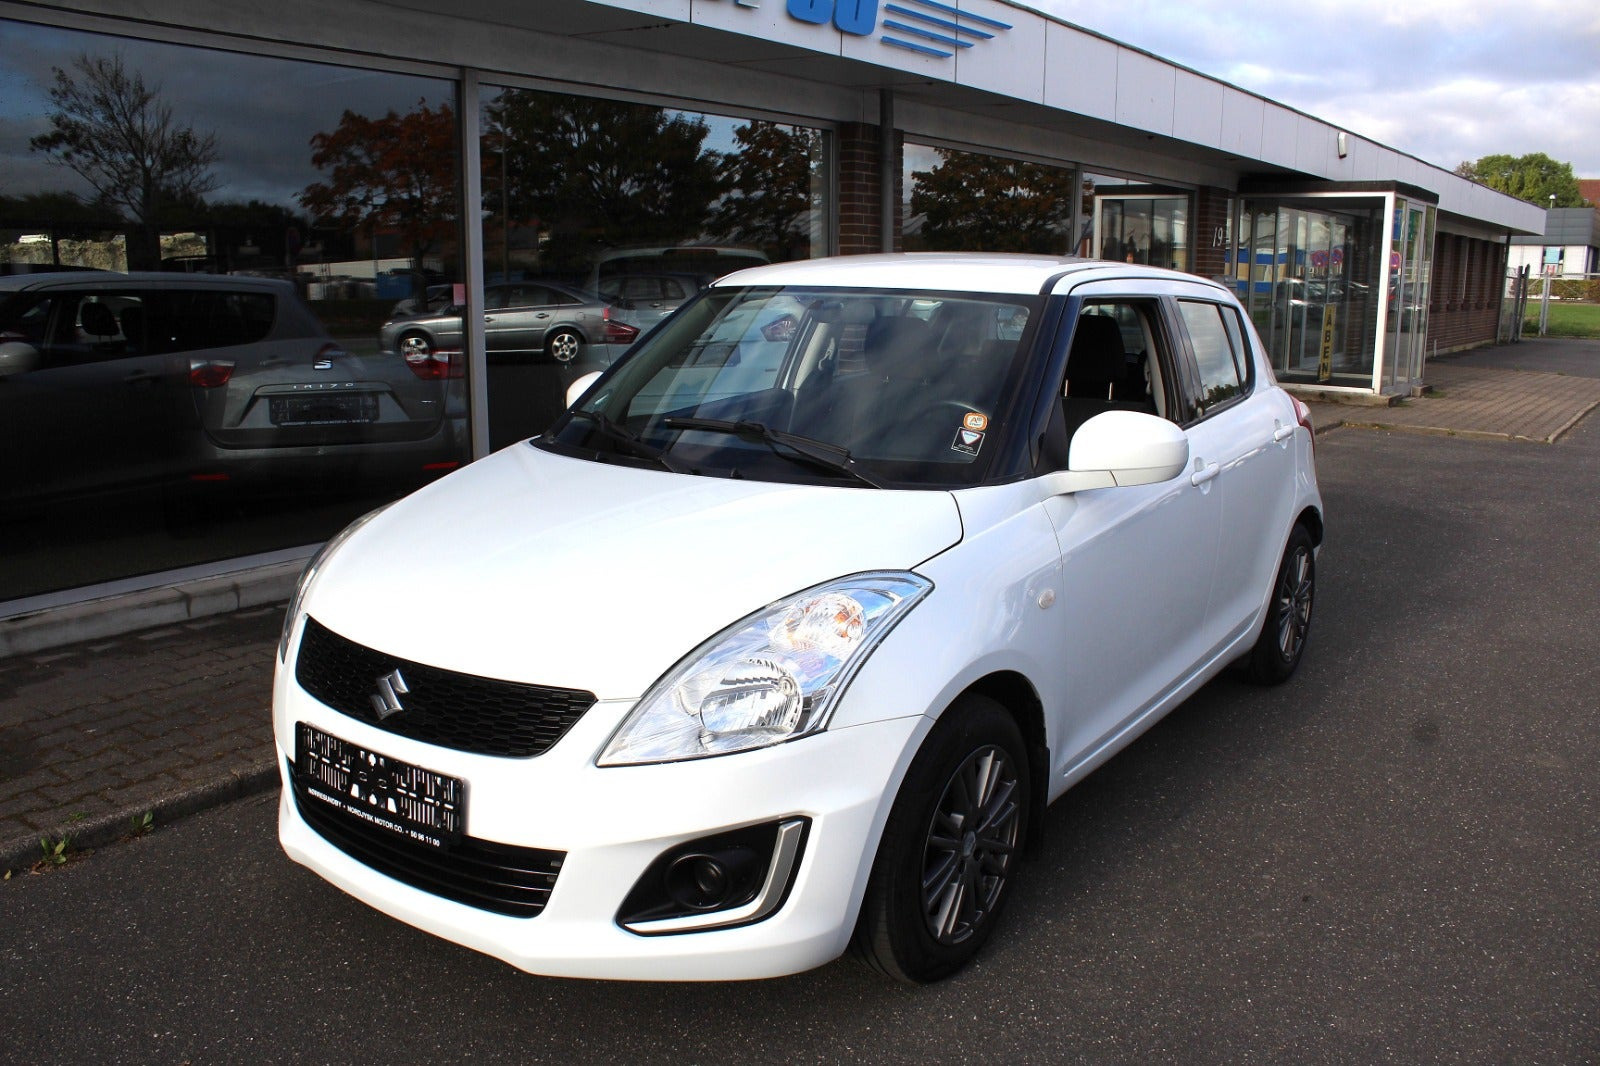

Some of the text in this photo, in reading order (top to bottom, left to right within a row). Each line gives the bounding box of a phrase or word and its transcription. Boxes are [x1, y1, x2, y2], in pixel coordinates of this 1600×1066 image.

[1212, 226, 1223, 248] 19
[374, 816, 394, 829] MOTOR
[425, 836, 432, 845] 11
